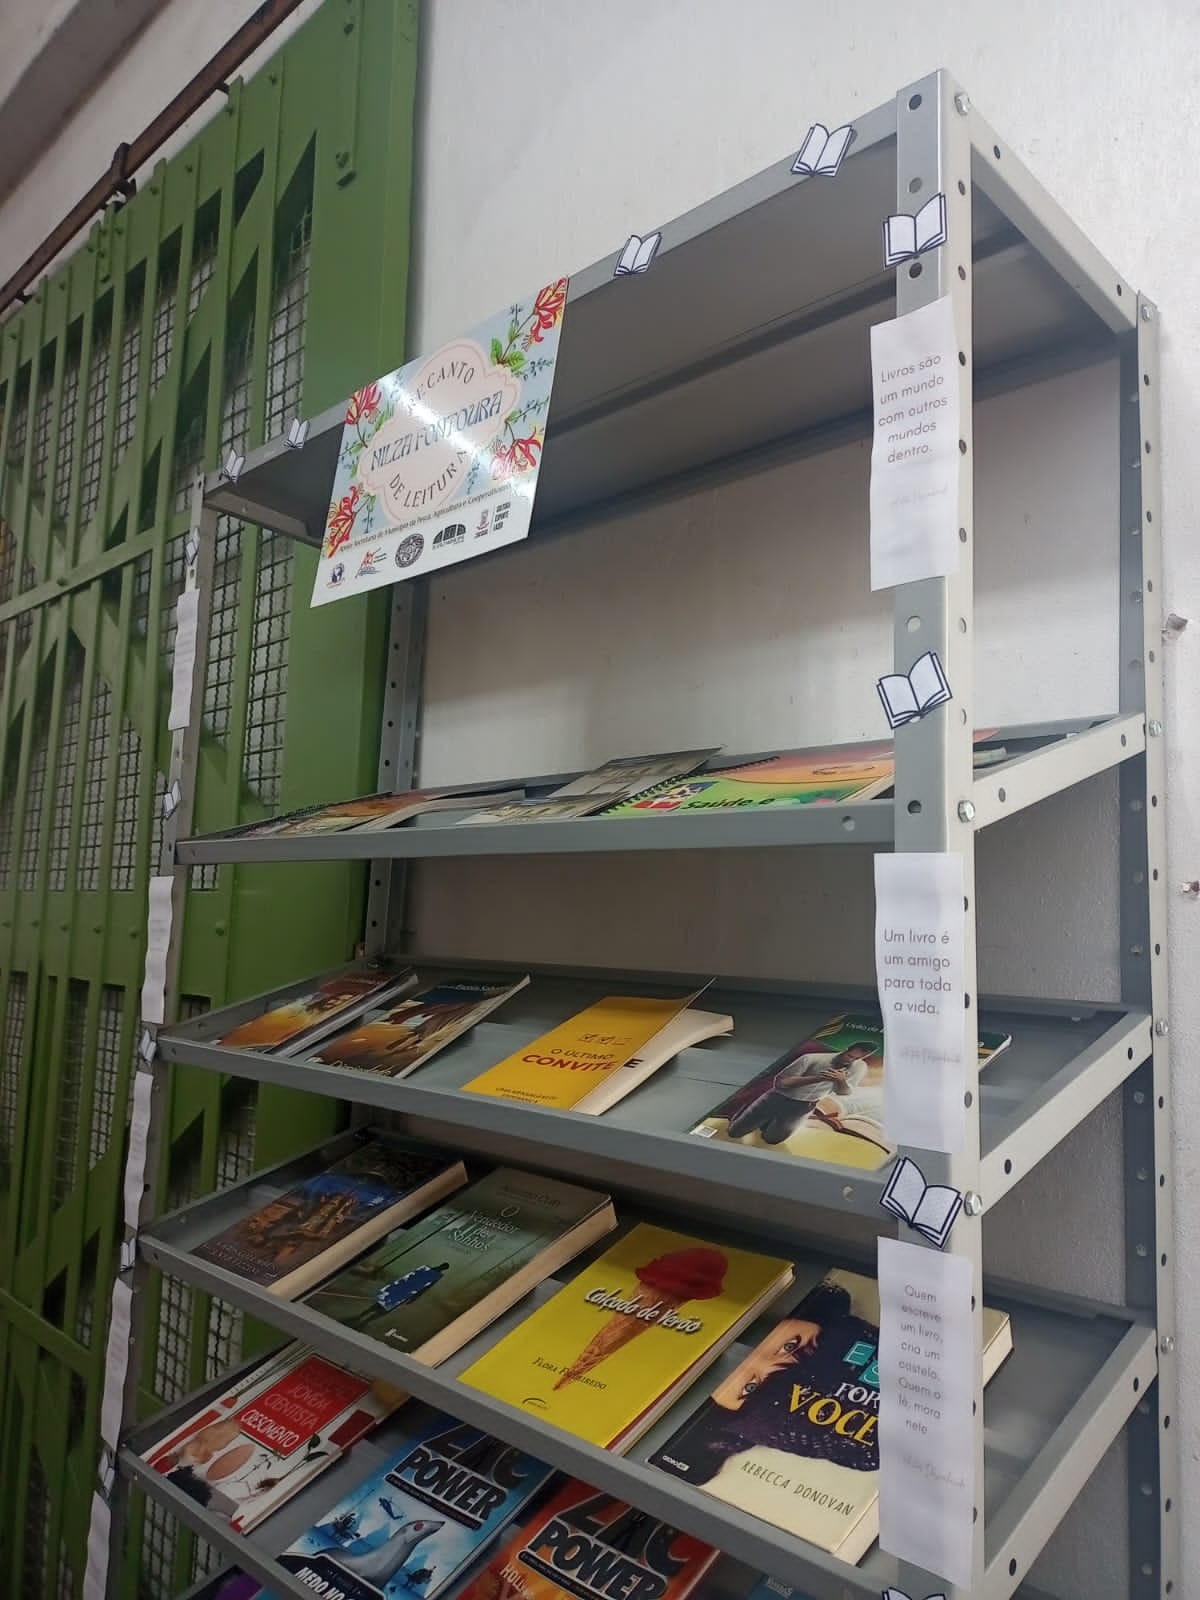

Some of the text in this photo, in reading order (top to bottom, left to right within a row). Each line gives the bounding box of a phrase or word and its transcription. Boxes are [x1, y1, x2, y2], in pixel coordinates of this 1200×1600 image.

[880, 354, 941, 383] Livros são
[407, 361, 475, 415] RECANTO
[880, 375, 944, 405] um mundo
[878, 396, 948, 427] com outros
[371, 390, 503, 471] NILZA FONTOURA
[887, 421, 937, 443] mundos
[887, 442, 932, 463] dentro.
[389, 449, 467, 508] DE LEITURA
[883, 929, 950, 945] Um livro é
[884, 953, 950, 972] um amigo
[884, 977, 951, 992] para toda
[893, 1000, 940, 1015] a vida.
[521, 1054, 618, 1072] CONVITE
[551, 1048, 614, 1061] O ÚLTIMO
[501, 1204, 520, 1218] O
[904, 1284, 937, 1303] Quem
[636, 1301, 660, 1321] de
[656, 1309, 703, 1334] Verão
[901, 1303, 942, 1323] escreve
[900, 1322, 916, 1334] um
[900, 1341, 941, 1361] cria um
[532, 1357, 558, 1372] FLORA
[898, 1377, 930, 1398] Quem
[264, 1393, 320, 1428] CIENTISTA
[913, 1400, 941, 1419] mora
[393, 1442, 507, 1519] POWER
[740, 1461, 855, 1516] REBECCA DONOVAN
[530, 1521, 668, 1600] POWER
[294, 1566, 329, 1593] MEDO
